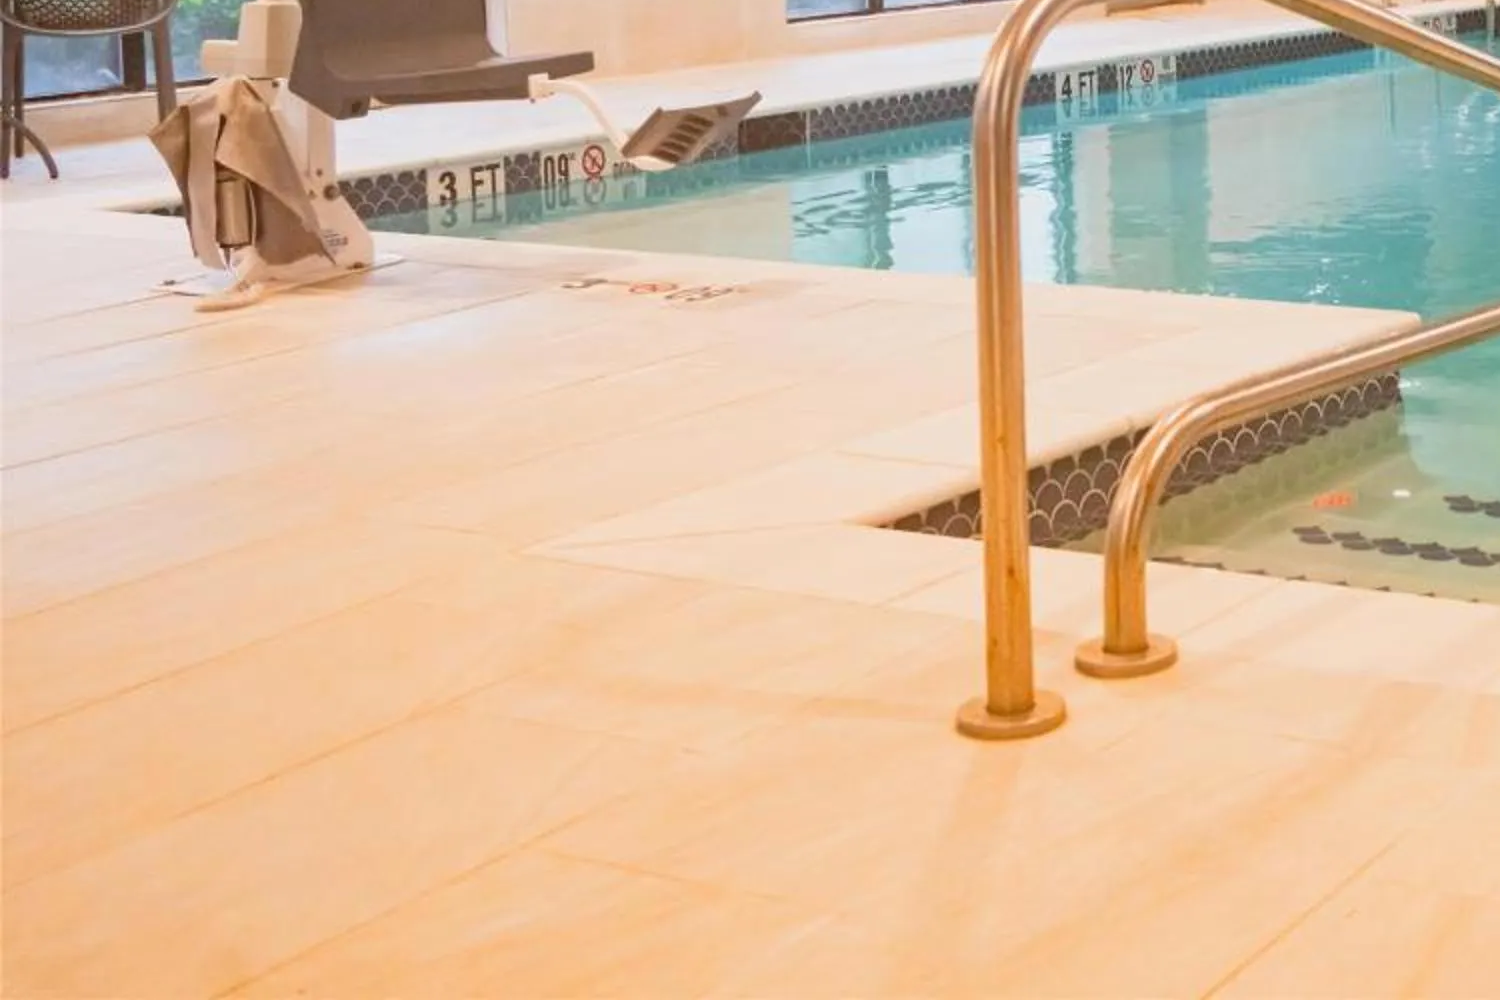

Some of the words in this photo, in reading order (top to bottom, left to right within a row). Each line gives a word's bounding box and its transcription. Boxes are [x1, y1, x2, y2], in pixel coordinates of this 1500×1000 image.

[1061, 73, 1073, 101] 4
[1078, 69, 1095, 99] FT
[438, 170, 458, 206] 3
[469, 161, 501, 200] FT
